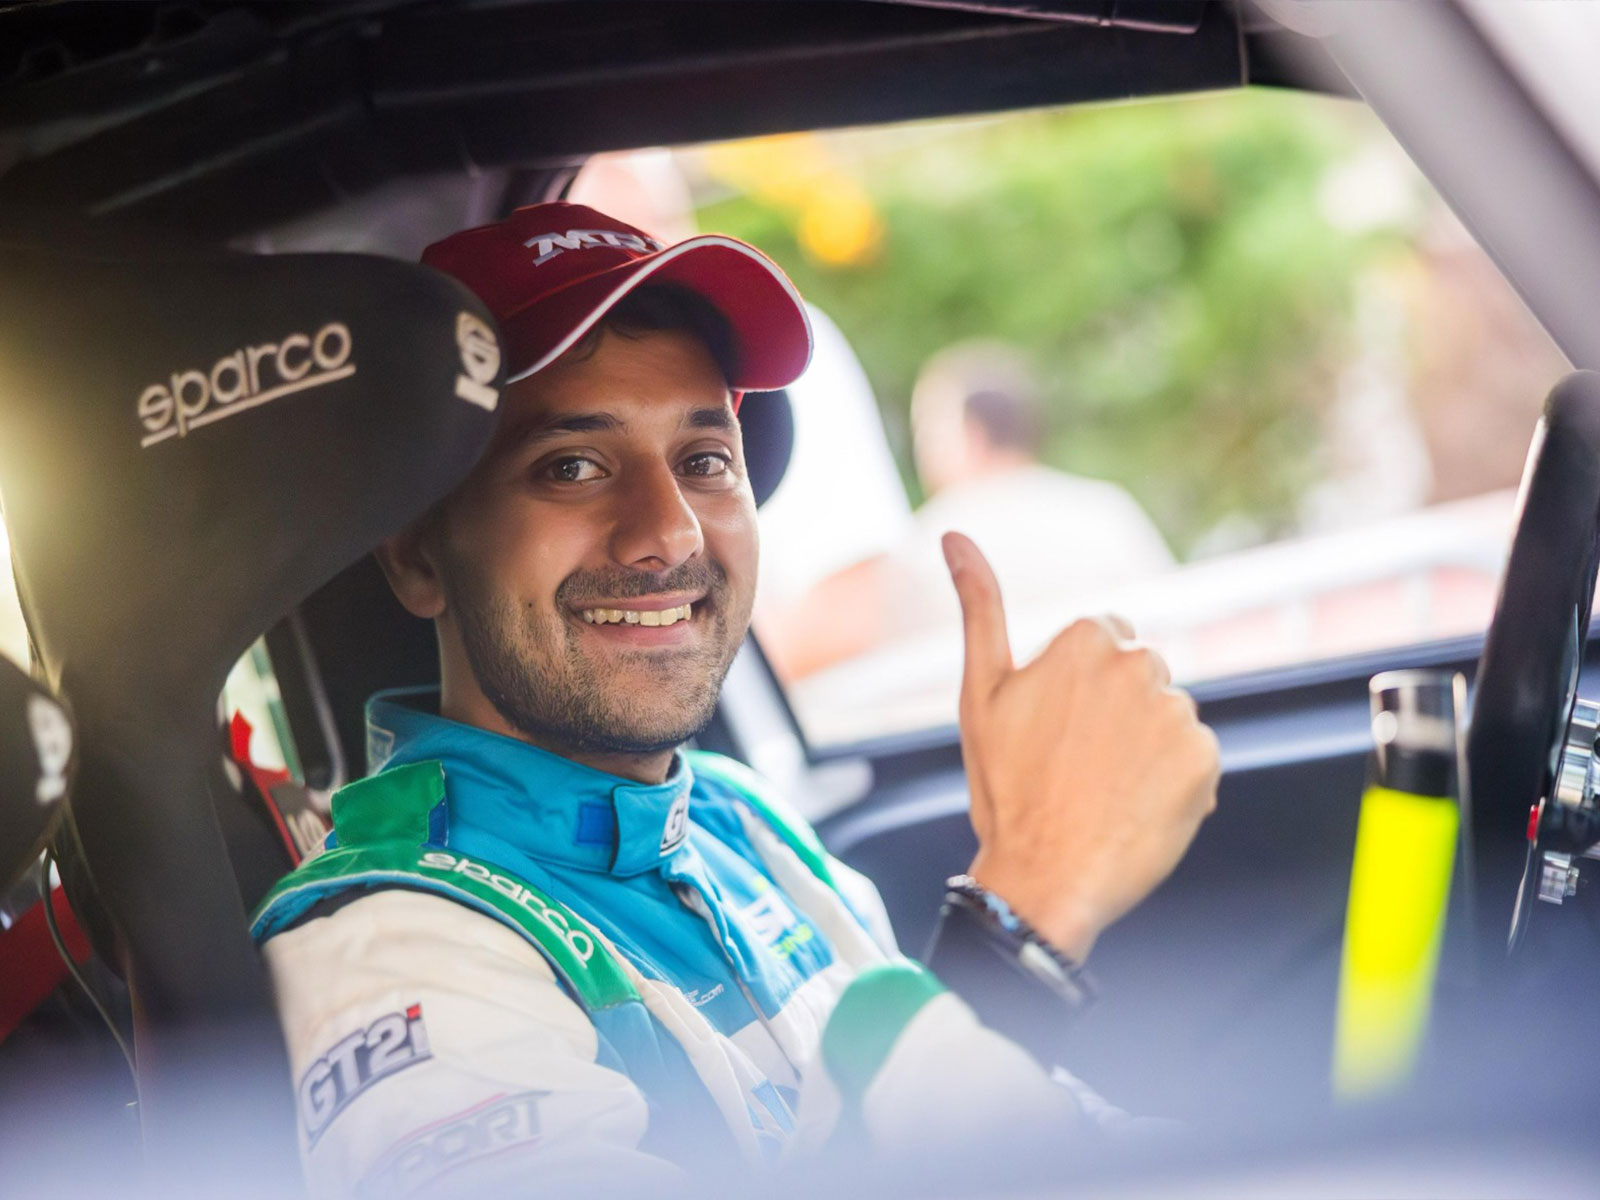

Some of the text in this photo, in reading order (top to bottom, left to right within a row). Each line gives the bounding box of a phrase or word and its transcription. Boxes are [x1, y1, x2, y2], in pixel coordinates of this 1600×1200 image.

[138, 322, 354, 446] sparco
[418, 853, 594, 968] sparco
[300, 1002, 432, 1142] GT2i
